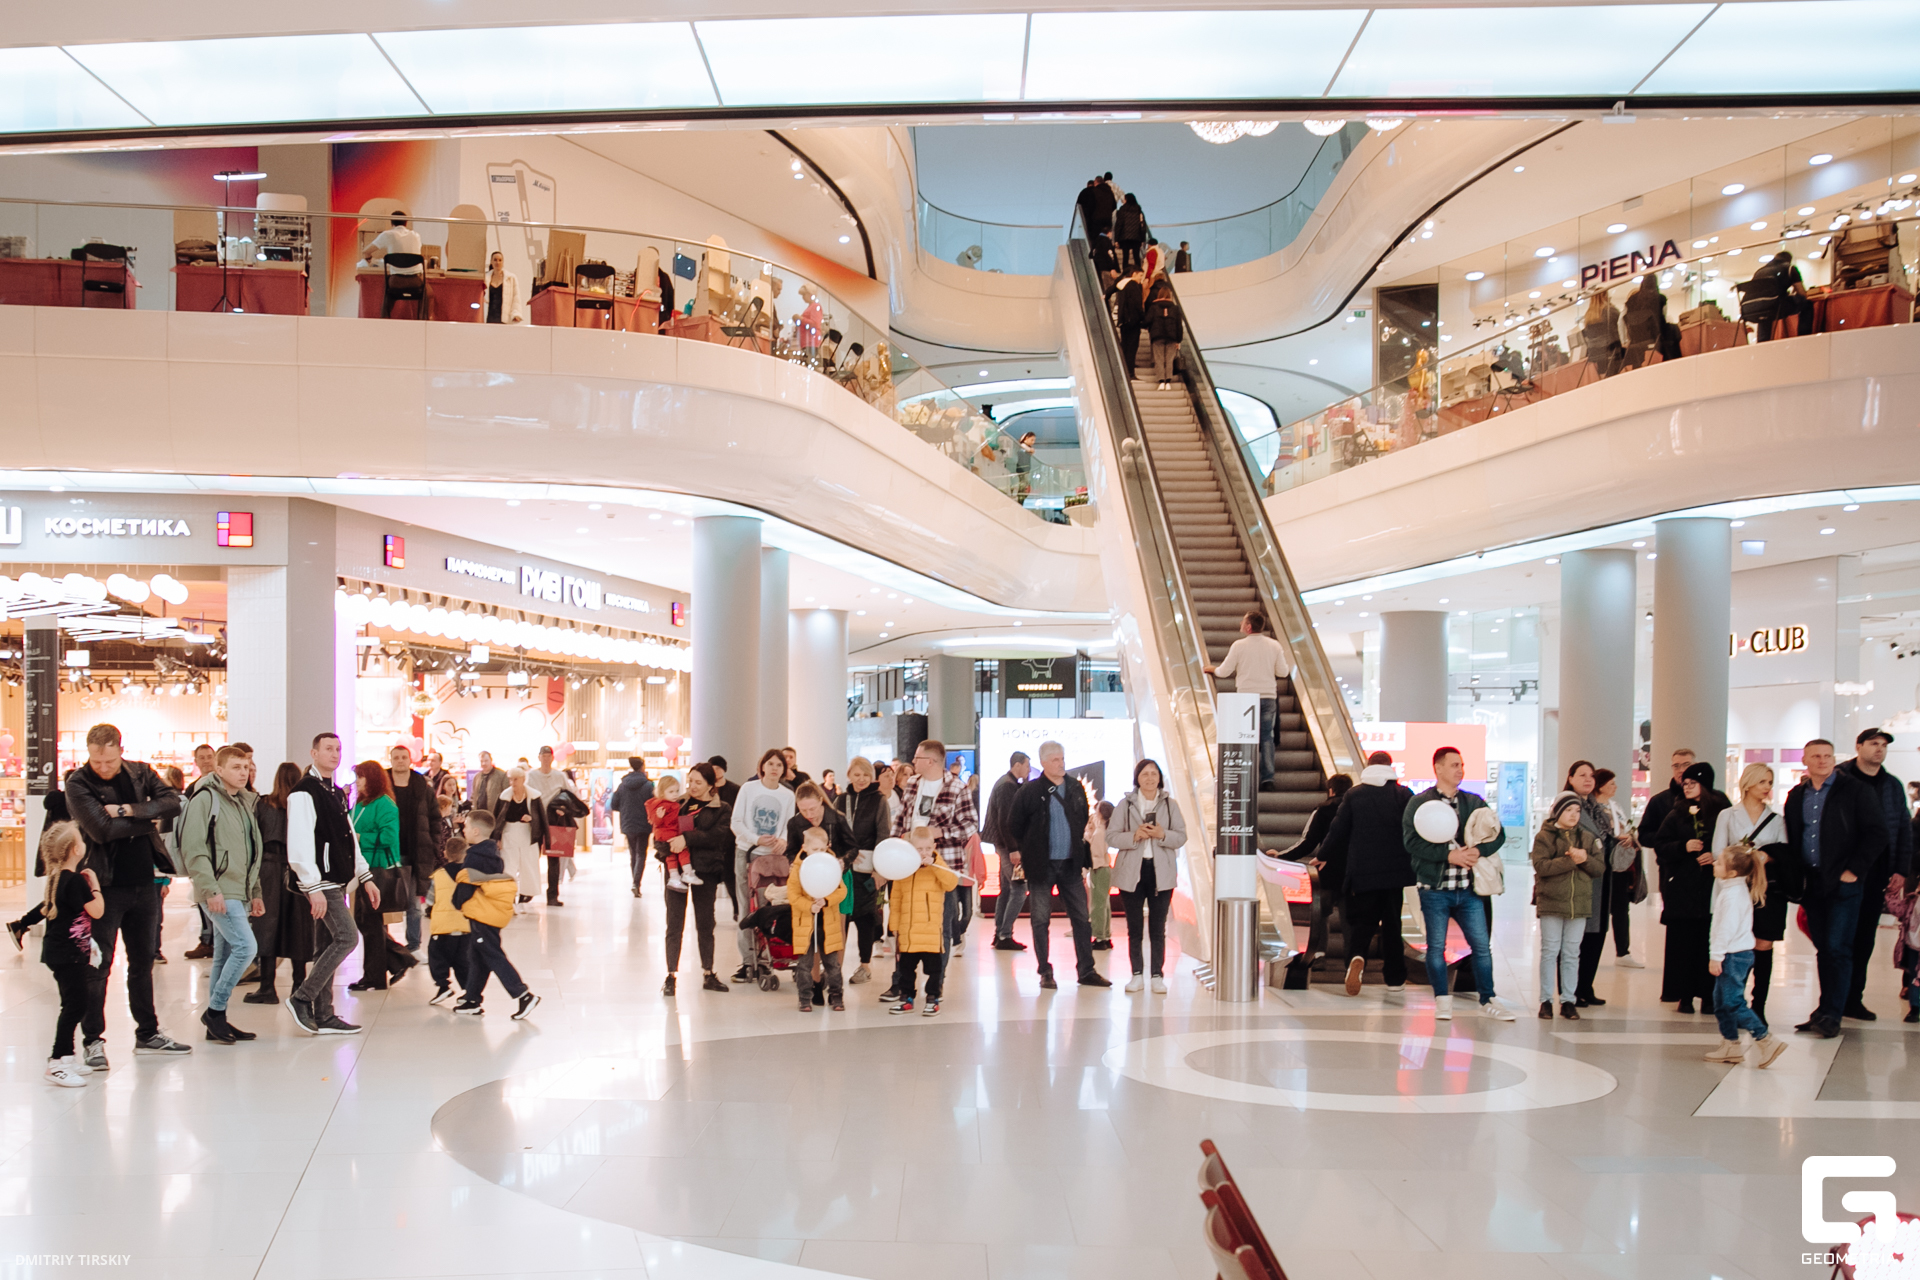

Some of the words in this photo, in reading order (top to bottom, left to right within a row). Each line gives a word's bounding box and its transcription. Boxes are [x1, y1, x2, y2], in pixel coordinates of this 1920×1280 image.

[1581, 239, 1682, 289] PiENA
[45, 517, 191, 537] КОСМЕТИКА
[521, 565, 561, 602] РИВ
[562, 575, 602, 611] ГОШ
[1751, 626, 1806, 653] CLUB
[1017, 683, 1048, 691] WONDER
[1048, 683, 1063, 691] FOX
[80, 696, 96, 710] So
[1243, 704, 1256, 731] 1
[1002, 729, 1049, 739] HONOR
